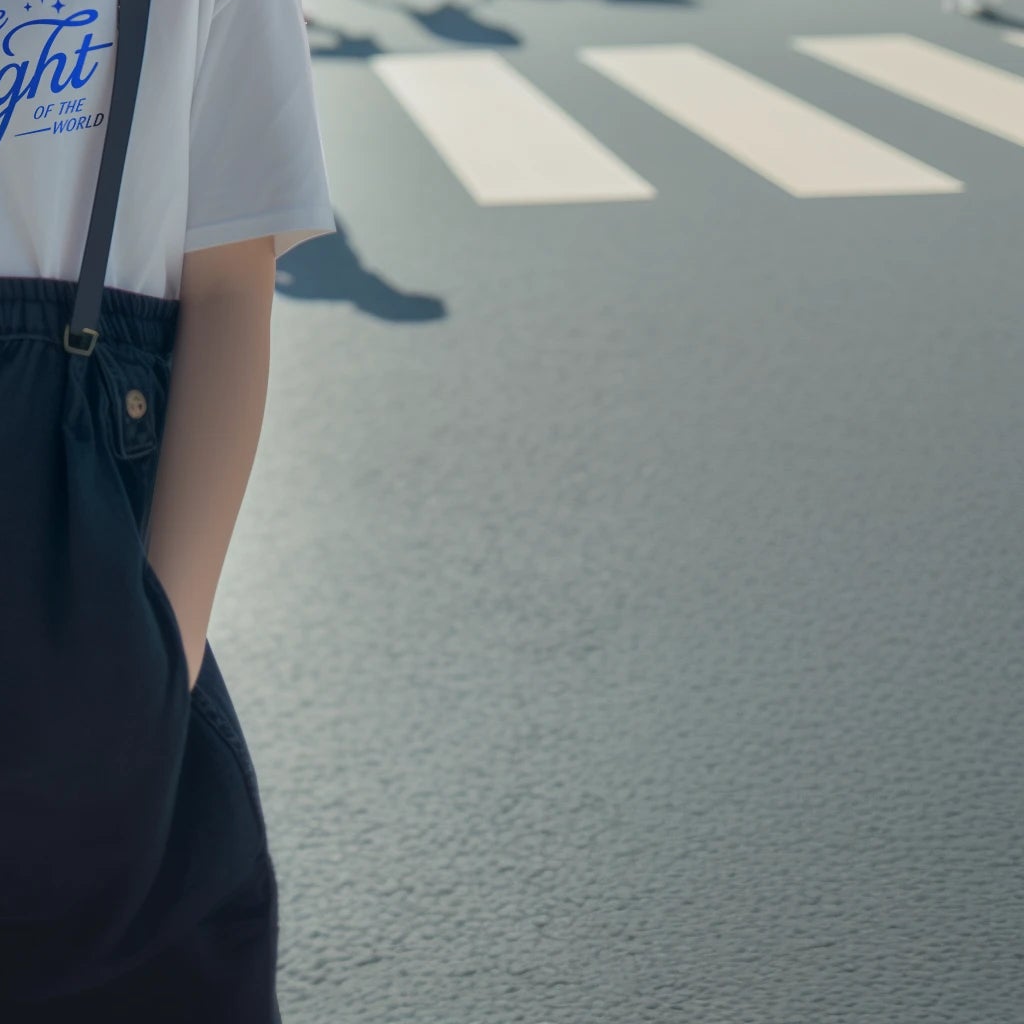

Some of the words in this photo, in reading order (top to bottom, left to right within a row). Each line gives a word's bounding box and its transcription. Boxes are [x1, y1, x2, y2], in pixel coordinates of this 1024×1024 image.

[33, 103, 55, 120] OF
[58, 97, 87, 116] THE
[52, 112, 105, 135] WORLD
